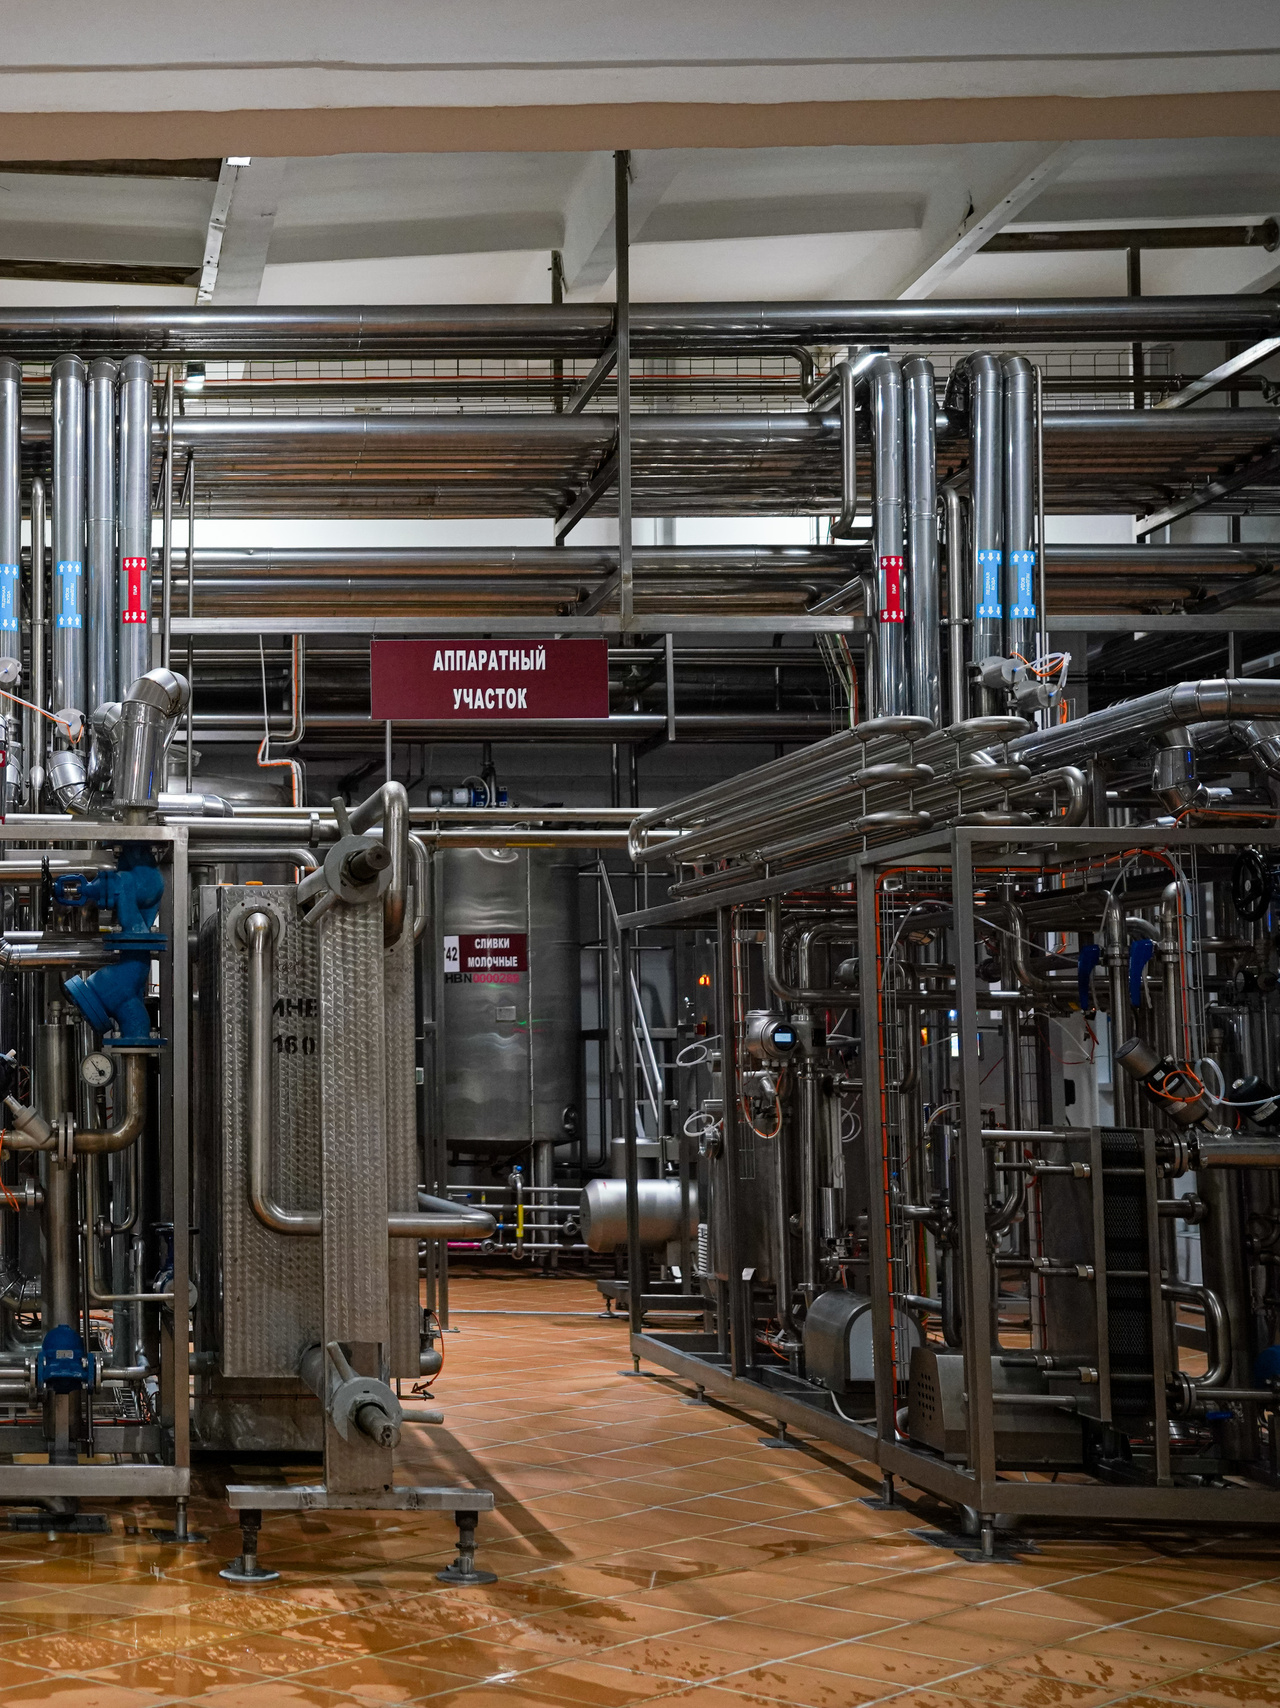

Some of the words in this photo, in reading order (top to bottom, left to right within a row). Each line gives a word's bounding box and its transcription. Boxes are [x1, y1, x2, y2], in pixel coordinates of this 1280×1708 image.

[433, 645, 546, 671] АППАРАТНЫЙ
[453, 688, 528, 710] УЧАСТОК
[474, 938, 510, 949] СЛИВКИ
[444, 947, 458, 961] 42
[467, 956, 518, 968] МОЛОЧНЫЕ
